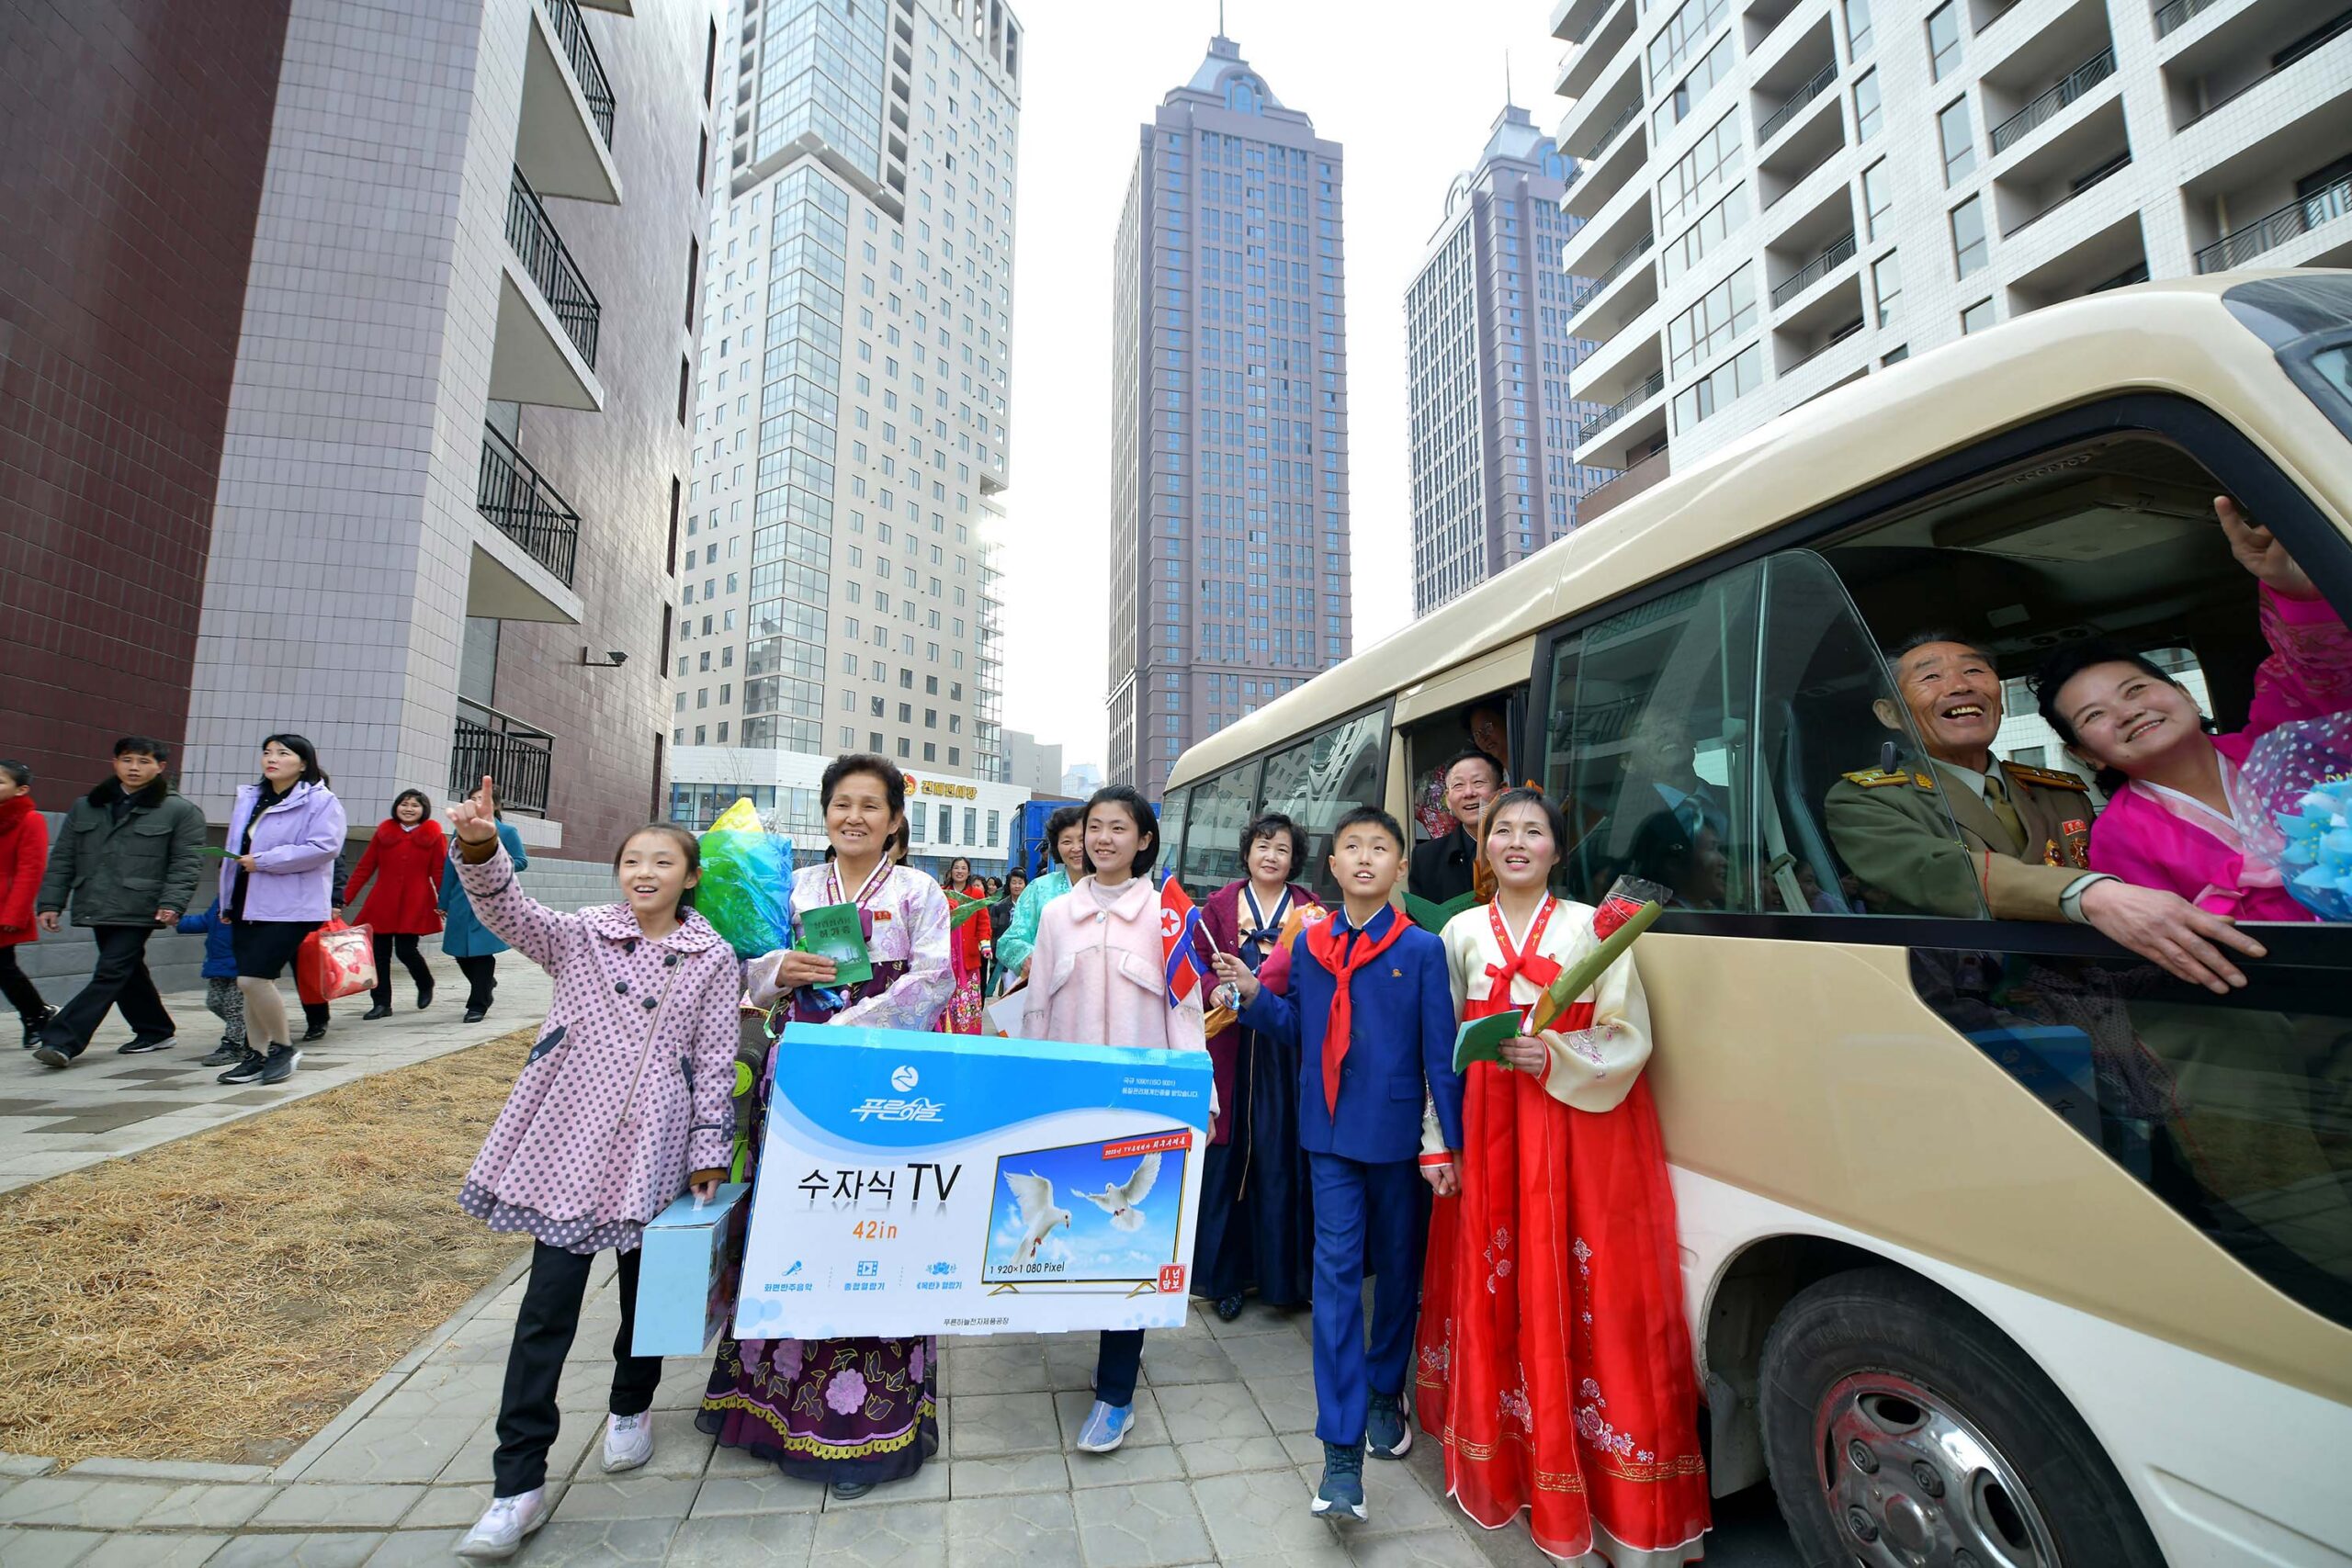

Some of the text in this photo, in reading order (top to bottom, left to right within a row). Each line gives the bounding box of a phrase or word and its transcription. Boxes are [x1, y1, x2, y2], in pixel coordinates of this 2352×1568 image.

[922, 780, 978, 800] 건재전시장
[850, 1097, 946, 1122] 푸른하늘
[797, 1163, 963, 1201] 수자식 TV
[853, 1220, 898, 1239] 42in
[1044, 1261, 1065, 1272] Pixel
[764, 1282, 813, 1292] 화면반주음악
[1162, 1279, 1180, 1290] 담보
